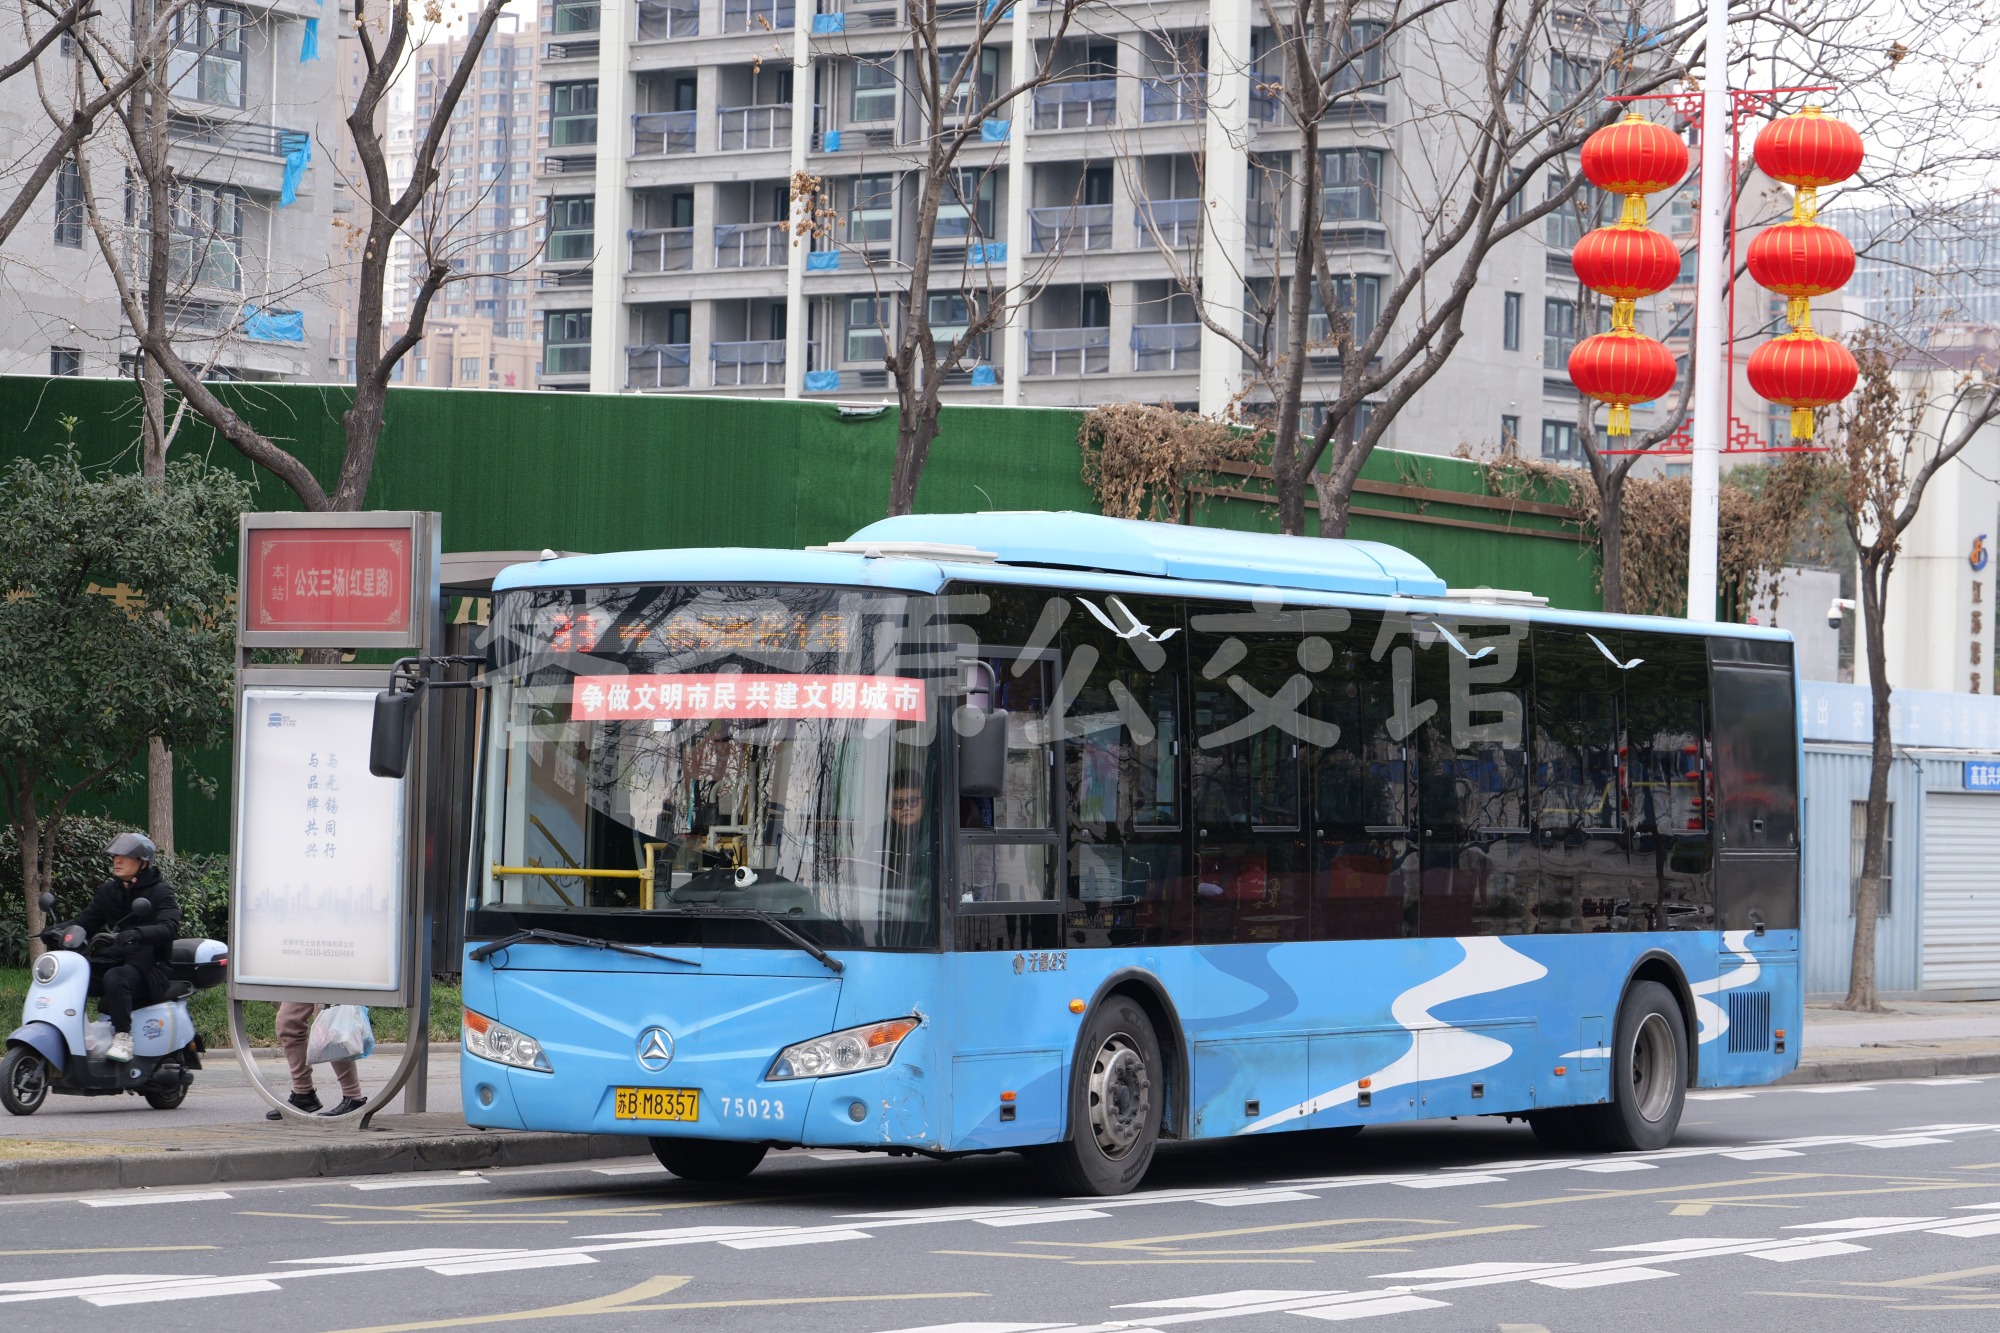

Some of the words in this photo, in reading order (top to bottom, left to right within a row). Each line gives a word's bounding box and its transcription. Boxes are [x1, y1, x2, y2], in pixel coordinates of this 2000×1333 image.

[272, 564, 285, 600] 本站
[295, 567, 393, 597] 公交三场(红星路)
[551, 615, 596, 652] 33
[581, 683, 737, 712] 争做文明市民
[745, 682, 921, 712] 共建文明城市
[305, 752, 319, 859] 与品牌共兴
[324, 752, 339, 859] 与无锡同行
[305, 949, 354, 957] 0510-85168484
[1028, 951, 1067, 972] 无锡公交
[617, 1092, 697, 1116] 苏B·M8357
[721, 1097, 784, 1120] 75023
